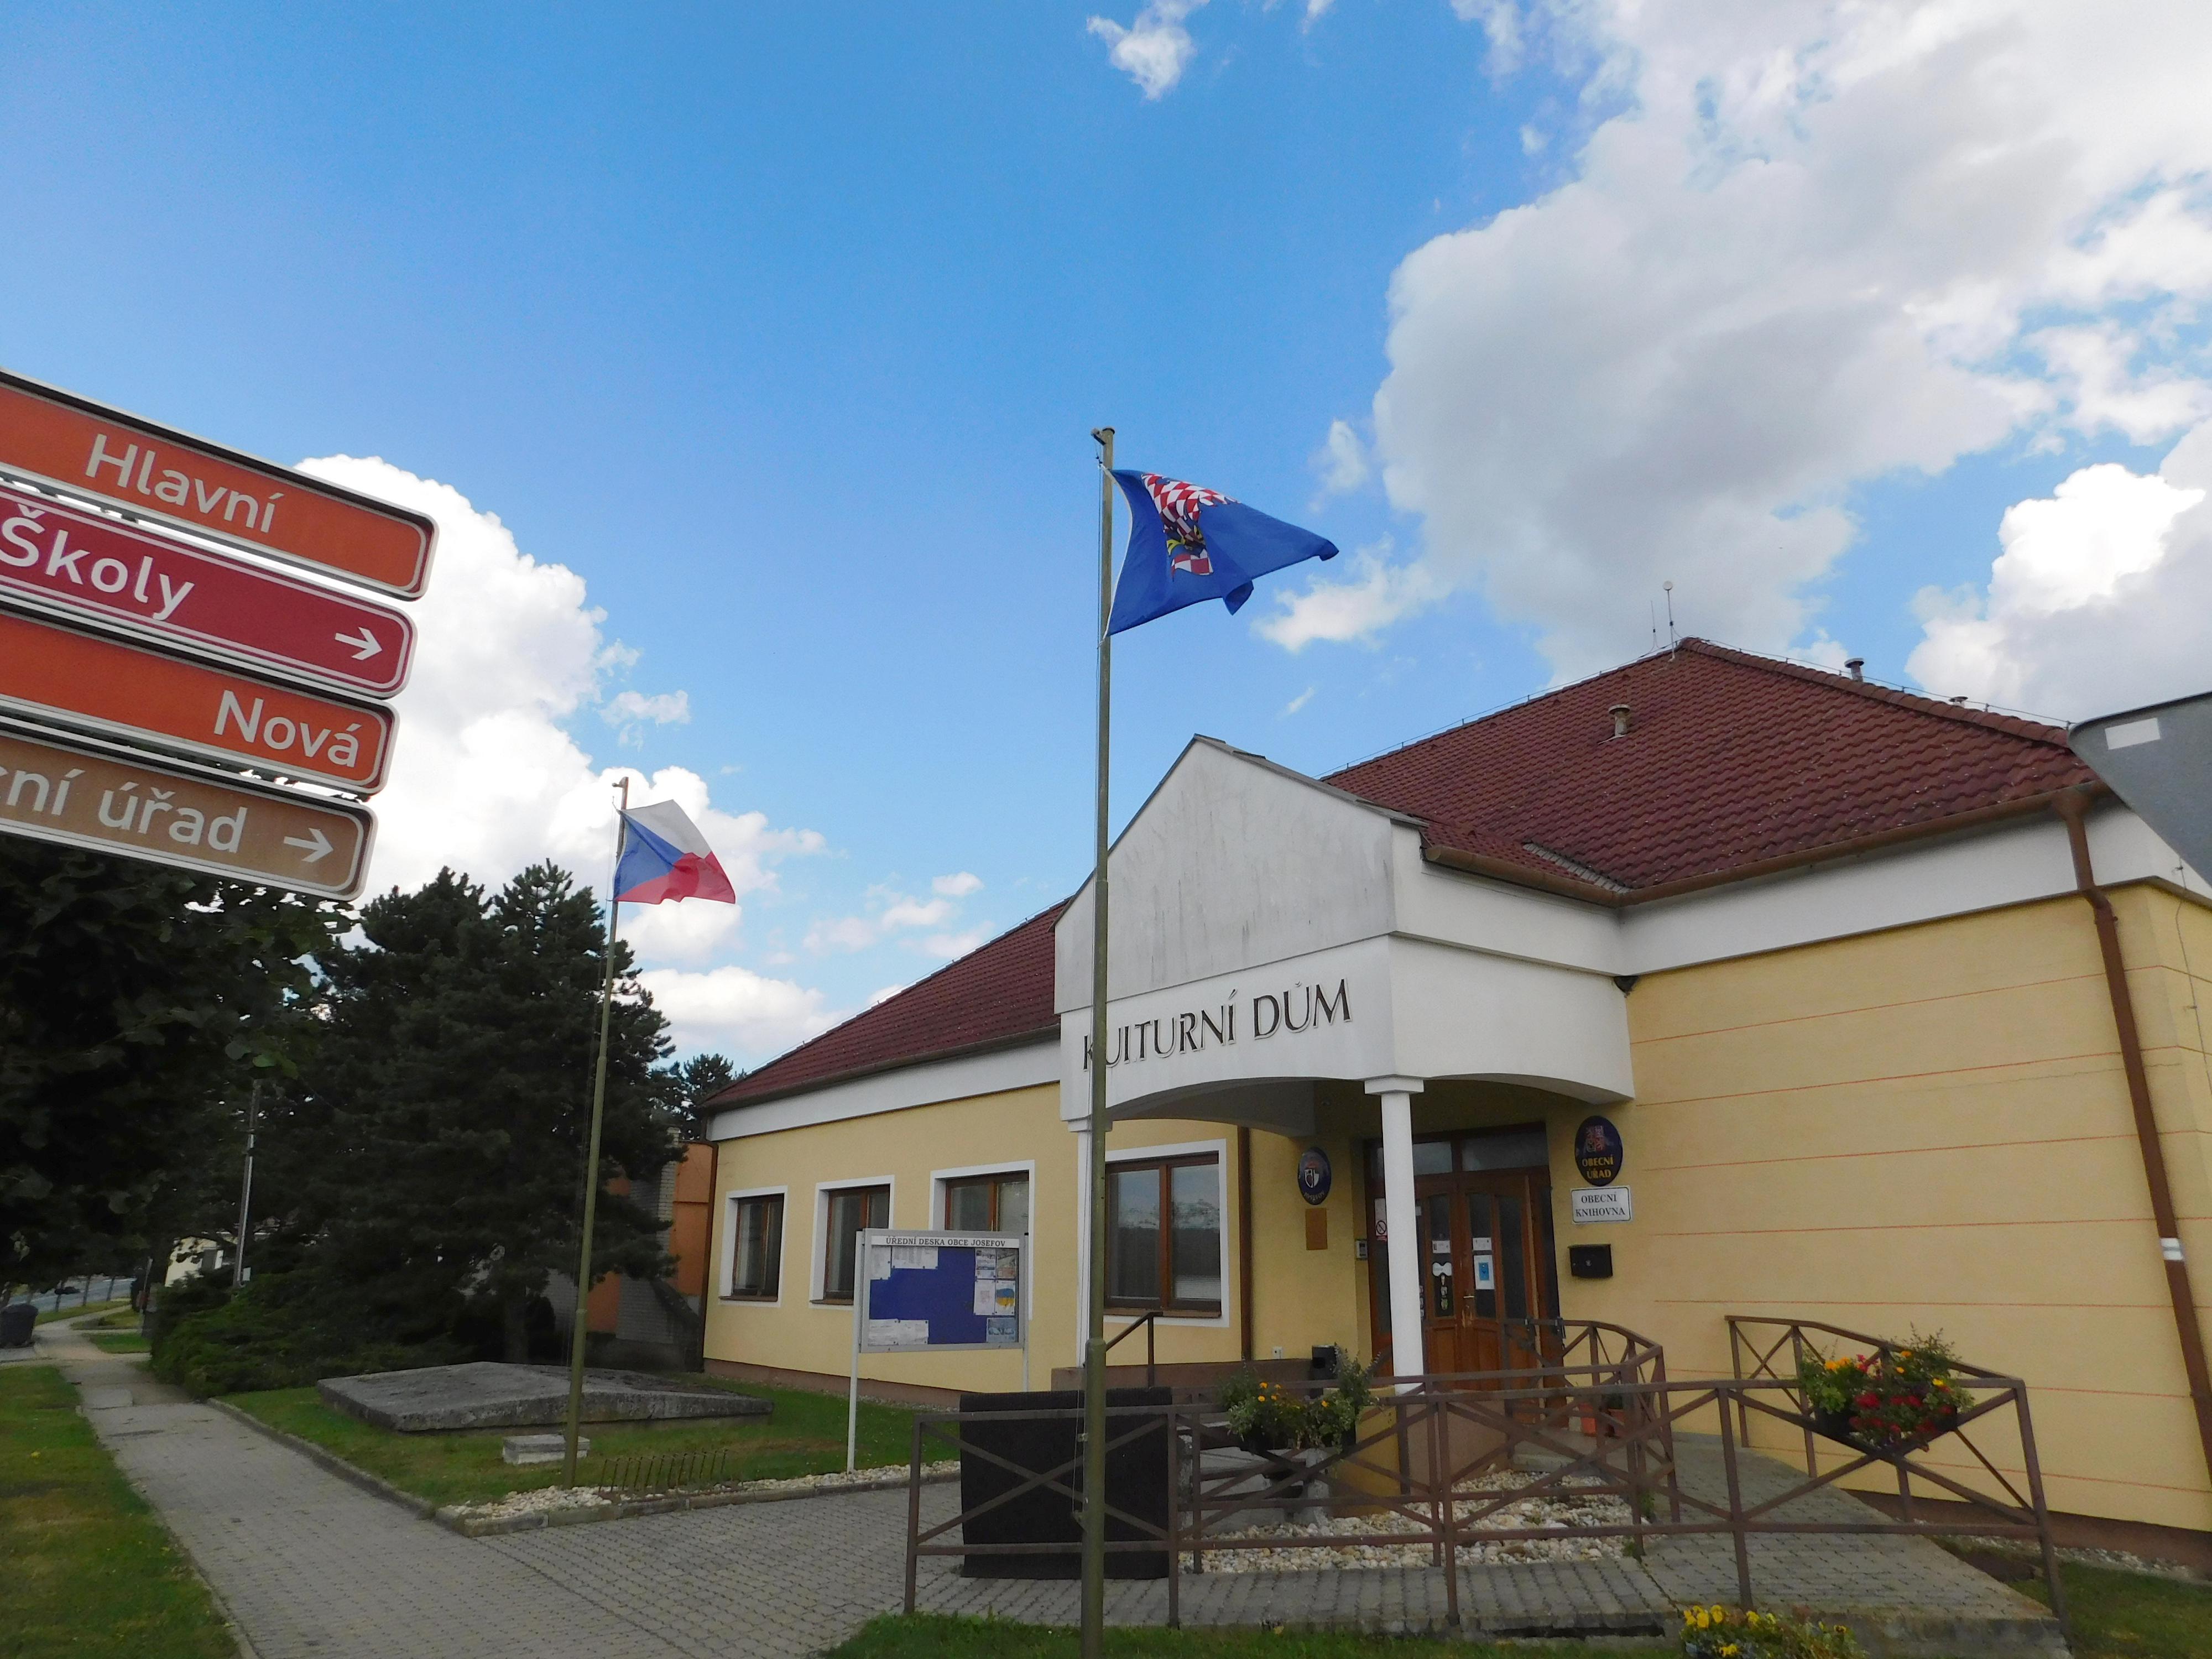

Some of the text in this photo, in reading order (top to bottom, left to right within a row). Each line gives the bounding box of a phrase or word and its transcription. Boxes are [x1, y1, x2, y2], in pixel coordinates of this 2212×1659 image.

[85, 434, 284, 533] Hlavní
[0, 504, 195, 621] Školy
[214, 690, 361, 768] Nová
[0, 765, 248, 853] ní úřad
[1253, 978, 1352, 1040] DŮM
[1582, 1155, 1614, 1167] OBECNÍ
[1575, 1207, 1626, 1217] KNIHOVNA
[1581, 1191, 1618, 1203] OBECNÍ
[886, 1235, 917, 1245] ÚŘEDNÍ
